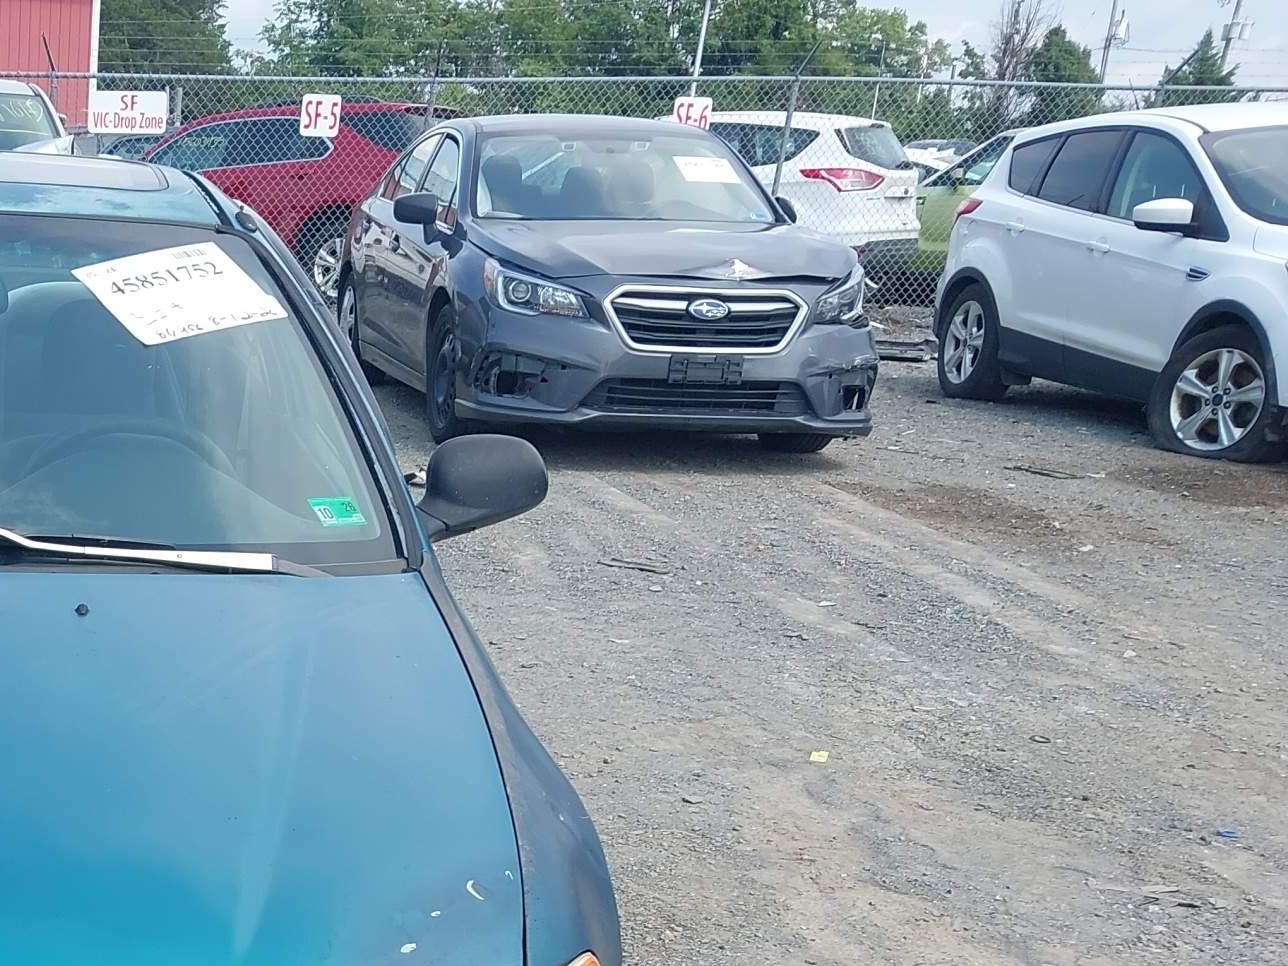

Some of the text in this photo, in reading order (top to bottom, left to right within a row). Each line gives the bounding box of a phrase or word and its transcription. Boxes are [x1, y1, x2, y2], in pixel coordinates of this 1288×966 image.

[120, 95, 138, 111] SF
[303, 99, 339, 130] SF-5
[92, 111, 164, 131] VIC-Drop Zone
[676, 102, 709, 129] SF-6
[110, 261, 224, 295] 45851752
[317, 507, 334, 520] 10
